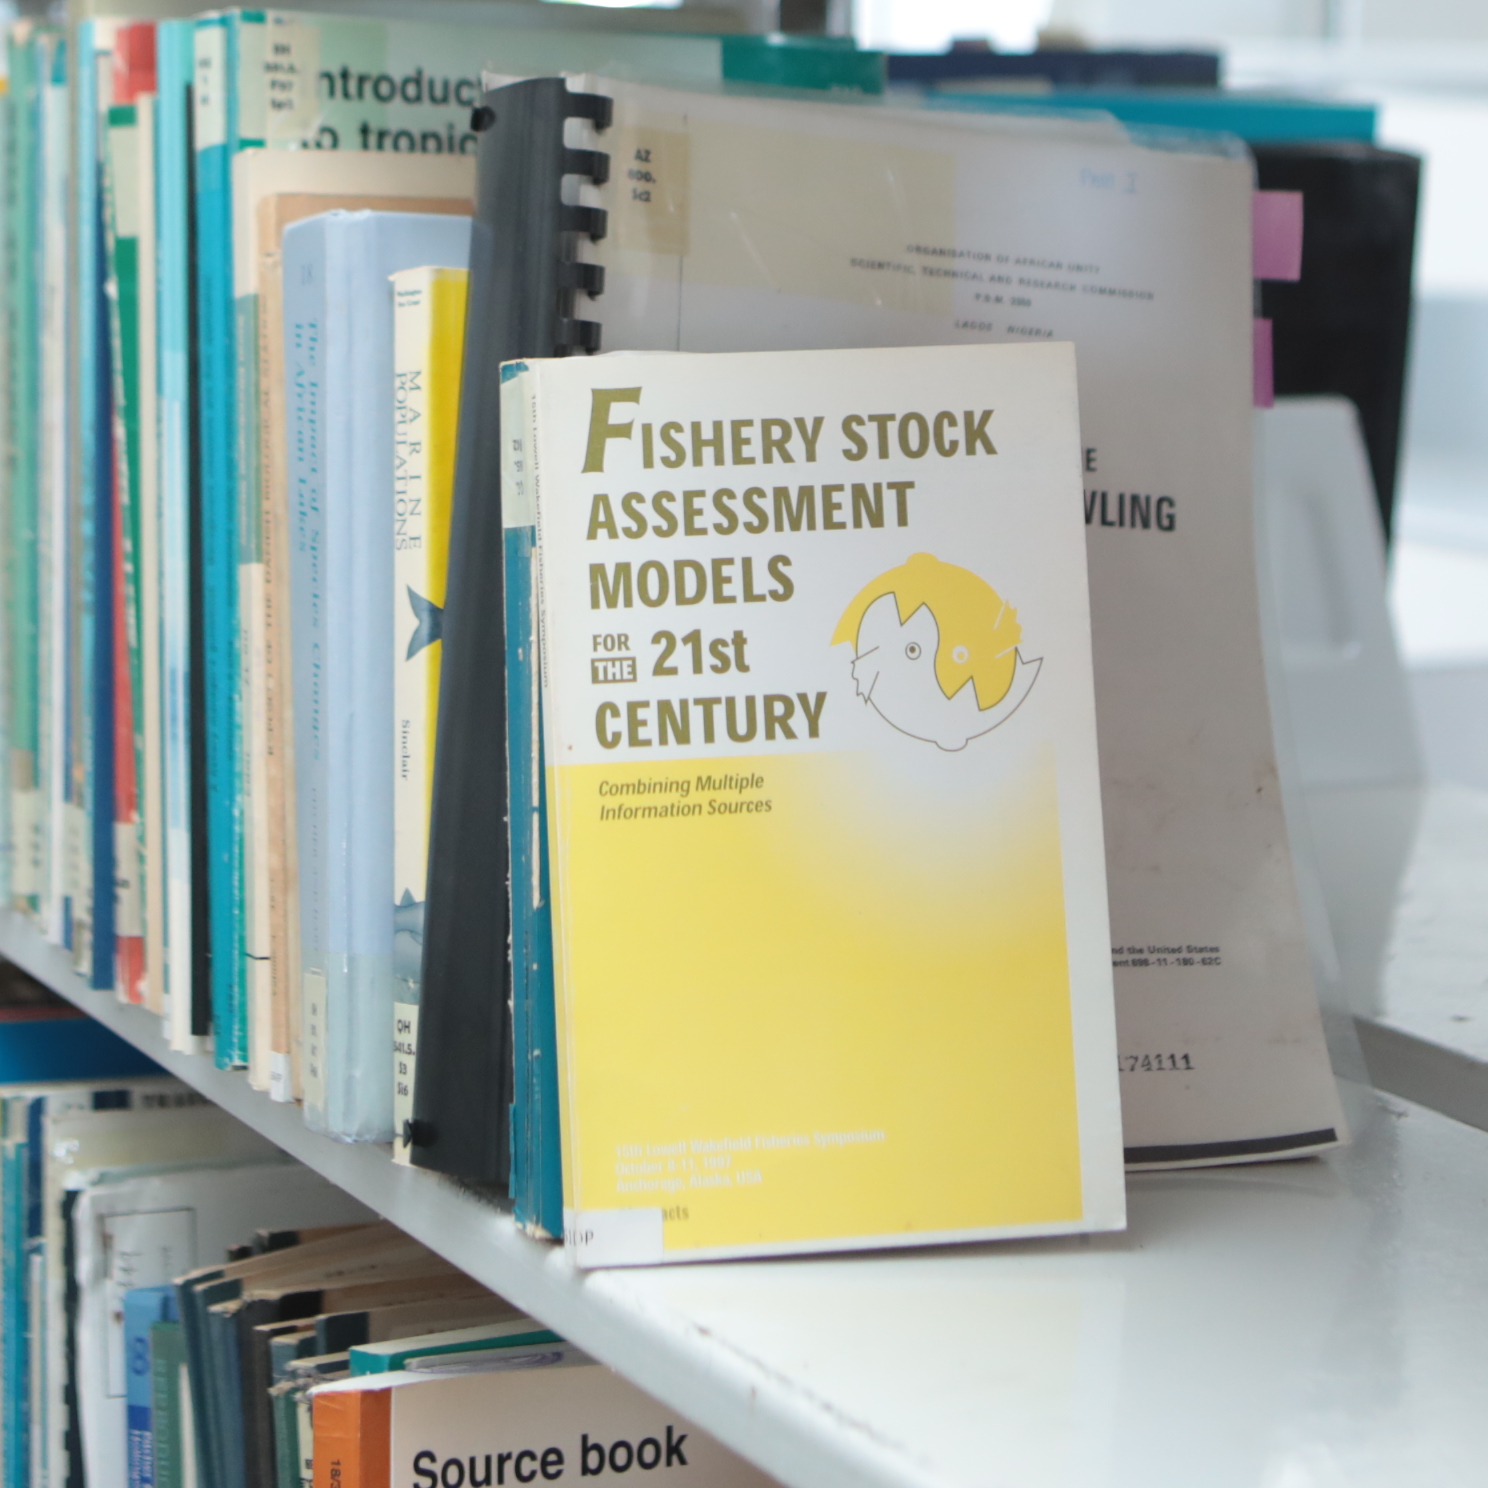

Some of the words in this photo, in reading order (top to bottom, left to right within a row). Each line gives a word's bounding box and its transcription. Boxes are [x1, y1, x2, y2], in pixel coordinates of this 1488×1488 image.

[320, 65, 482, 107] ntroduc
[361, 118, 479, 155] tropic
[922, 265, 985, 282] TECHNICAL
[989, 273, 1013, 285] AND
[1018, 276, 1077, 293] RESEARCH
[1081, 284, 1155, 302] COMMISSION
[996, 254, 1011, 264] OF
[1014, 256, 1064, 271] AFRICAN
[954, 318, 994, 333] LAGOS
[1006, 324, 1055, 339] NIGERIA
[308, 381, 320, 474] Impact
[580, 386, 825, 474] FISHERY
[841, 409, 999, 463] STOCK
[396, 371, 408, 552] POPULATIONS
[409, 369, 423, 550] MARINE
[586, 480, 916, 541] ASSESSMENT
[310, 528, 322, 628] Species
[588, 554, 795, 610] MODELS
[592, 633, 631, 653] FOR
[650, 629, 751, 677] 21st
[593, 658, 635, 683] THE
[595, 691, 828, 750] CENTURY
[401, 719, 411, 782] Sinclair
[599, 776, 691, 798] Combining
[695, 772, 764, 792] Multiple
[599, 801, 703, 821] Information
[707, 797, 773, 816] Sources
[1126, 945, 1144, 954] the
[1147, 945, 1183, 954] United
[1186, 944, 1221, 954] States
[647, 1141, 687, 1158] Lowell
[691, 1137, 752, 1155] Wakefield
[755, 1133, 810, 1151] Fisheries
[813, 1129, 886, 1149] Symposium
[615, 1160, 663, 1176] October
[736, 1168, 762, 1186] USA
[413, 1446, 566, 1488] Source
[580, 1424, 690, 1478] book
